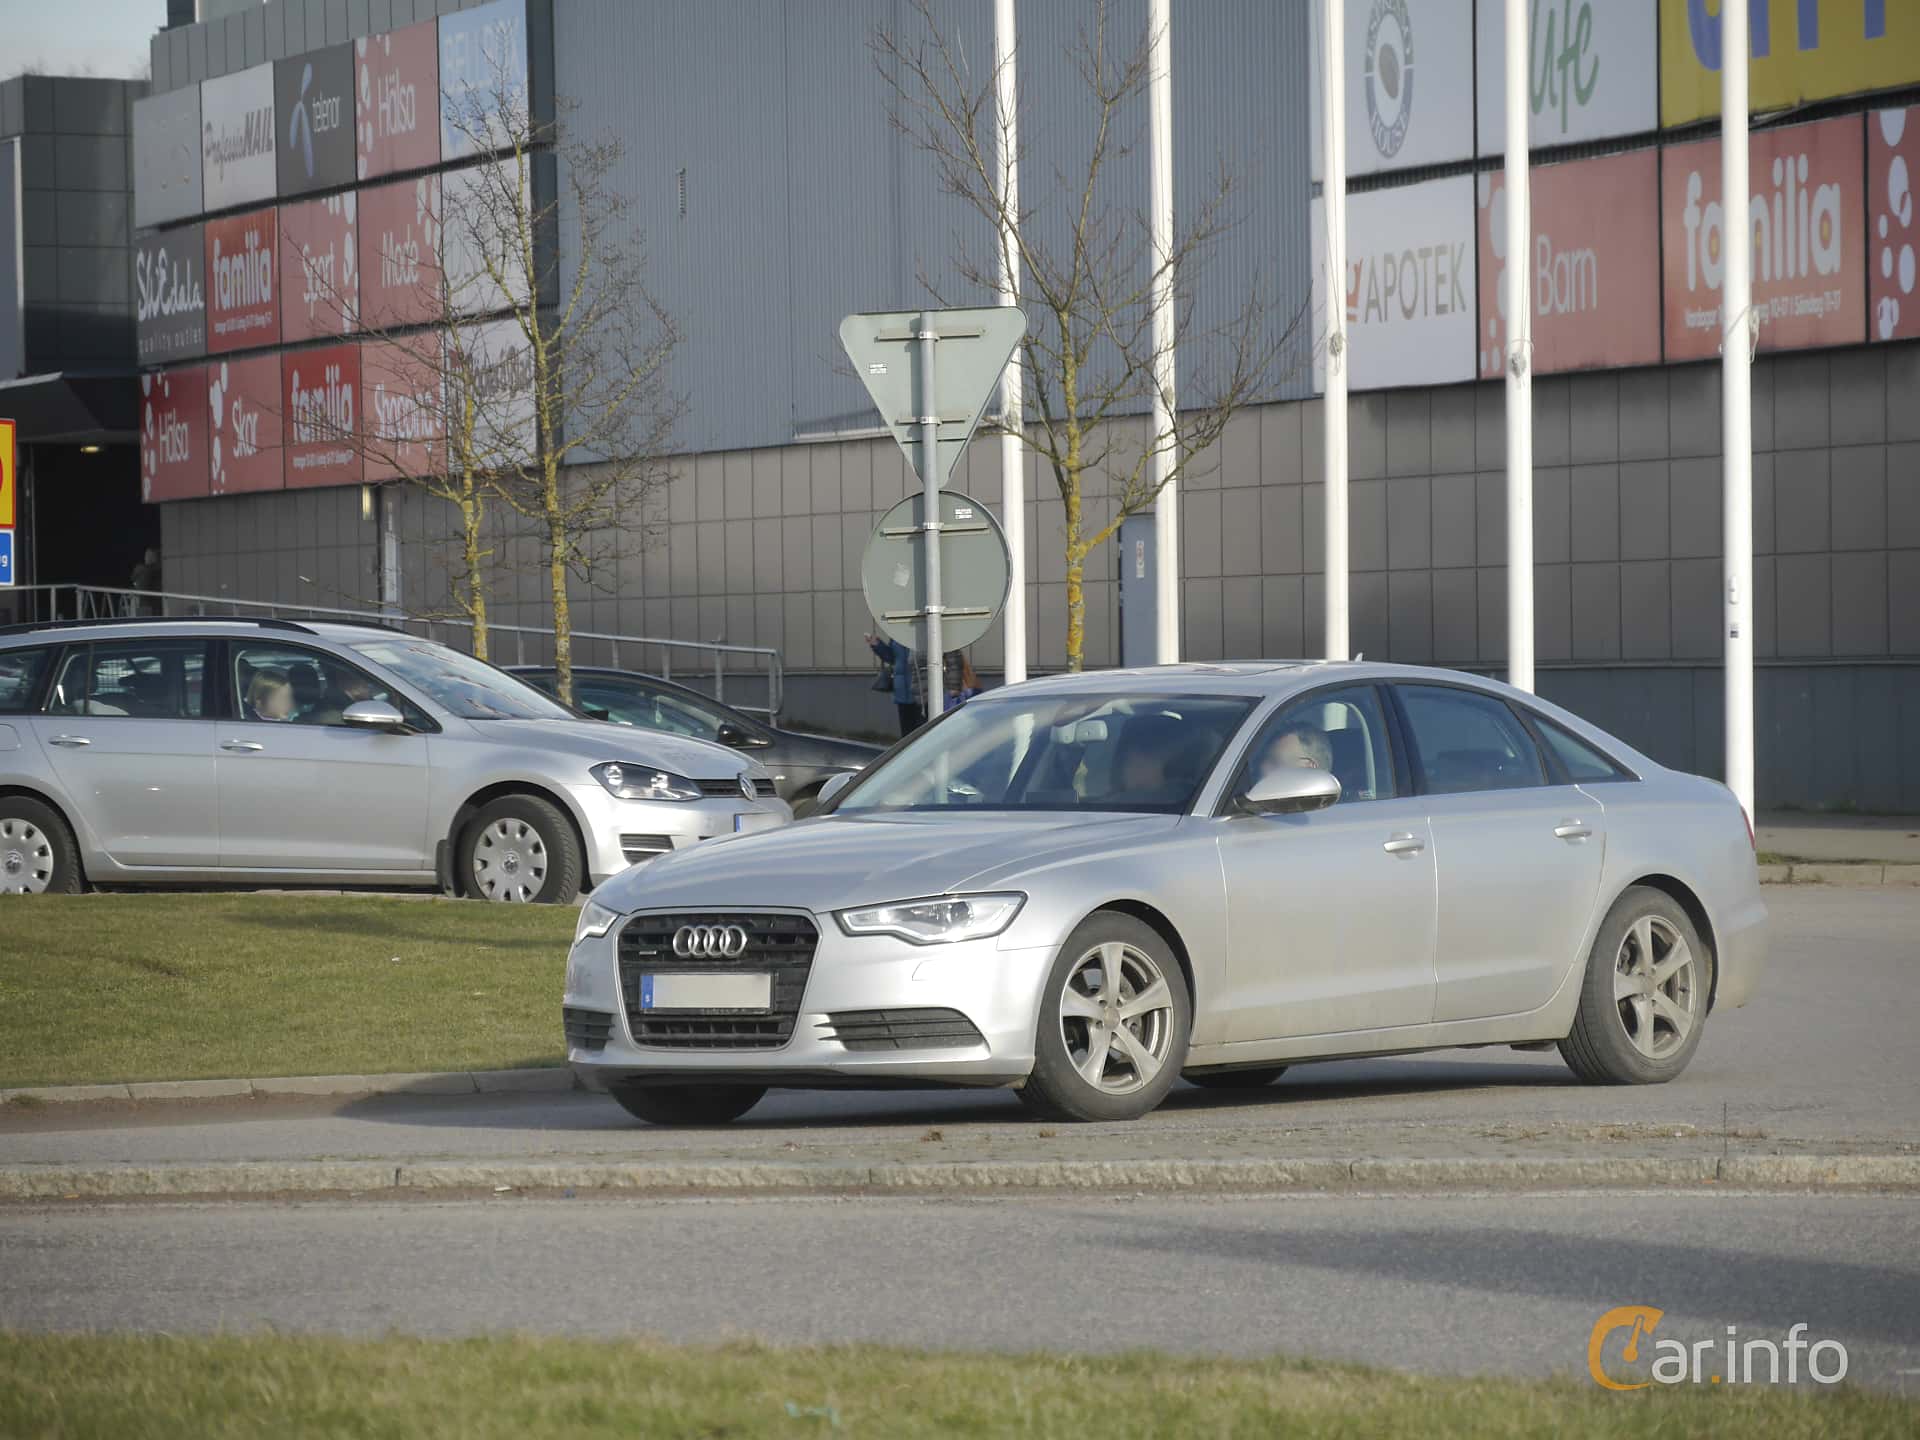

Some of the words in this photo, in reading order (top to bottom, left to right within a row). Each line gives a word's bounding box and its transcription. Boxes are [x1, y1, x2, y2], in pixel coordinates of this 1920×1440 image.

[312, 93, 340, 134] telenor
[378, 69, 416, 137] Hälsa
[213, 229, 271, 311] familia
[303, 241, 335, 318] Sport
[382, 224, 420, 288] Mode
[1364, 241, 1467, 324] APOTEK
[1536, 234, 1598, 316] Barn
[159, 407, 189, 463] Hälsa
[232, 397, 258, 458] Skor
[292, 364, 353, 445] familia
